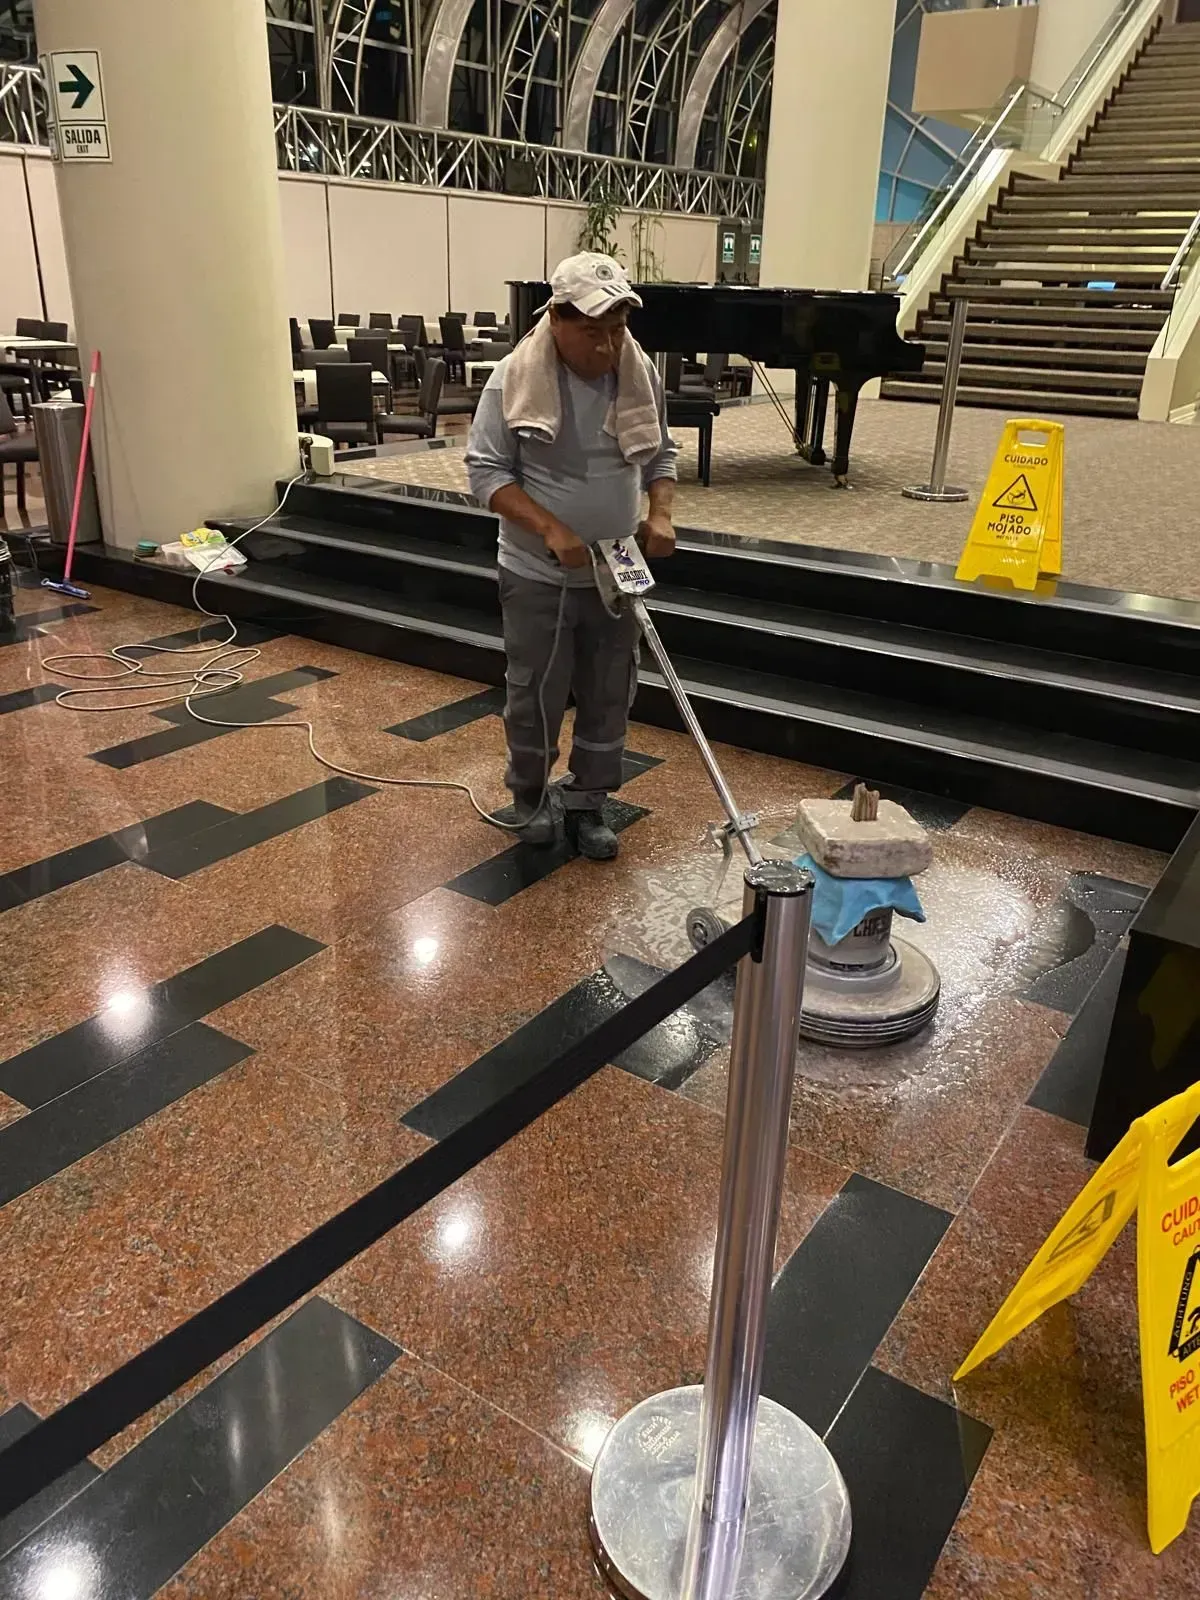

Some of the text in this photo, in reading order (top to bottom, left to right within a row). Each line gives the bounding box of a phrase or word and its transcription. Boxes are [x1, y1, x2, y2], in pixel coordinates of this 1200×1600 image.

[65, 129, 102, 144] SALIDA
[76, 145, 89, 153] EXIT
[1004, 454, 1048, 465] CUIDADO
[1000, 513, 1024, 524] PISO
[987, 522, 1031, 535] MOJADO
[1161, 1196, 1200, 1232] CUID
[1169, 1369, 1194, 1399] PISO
